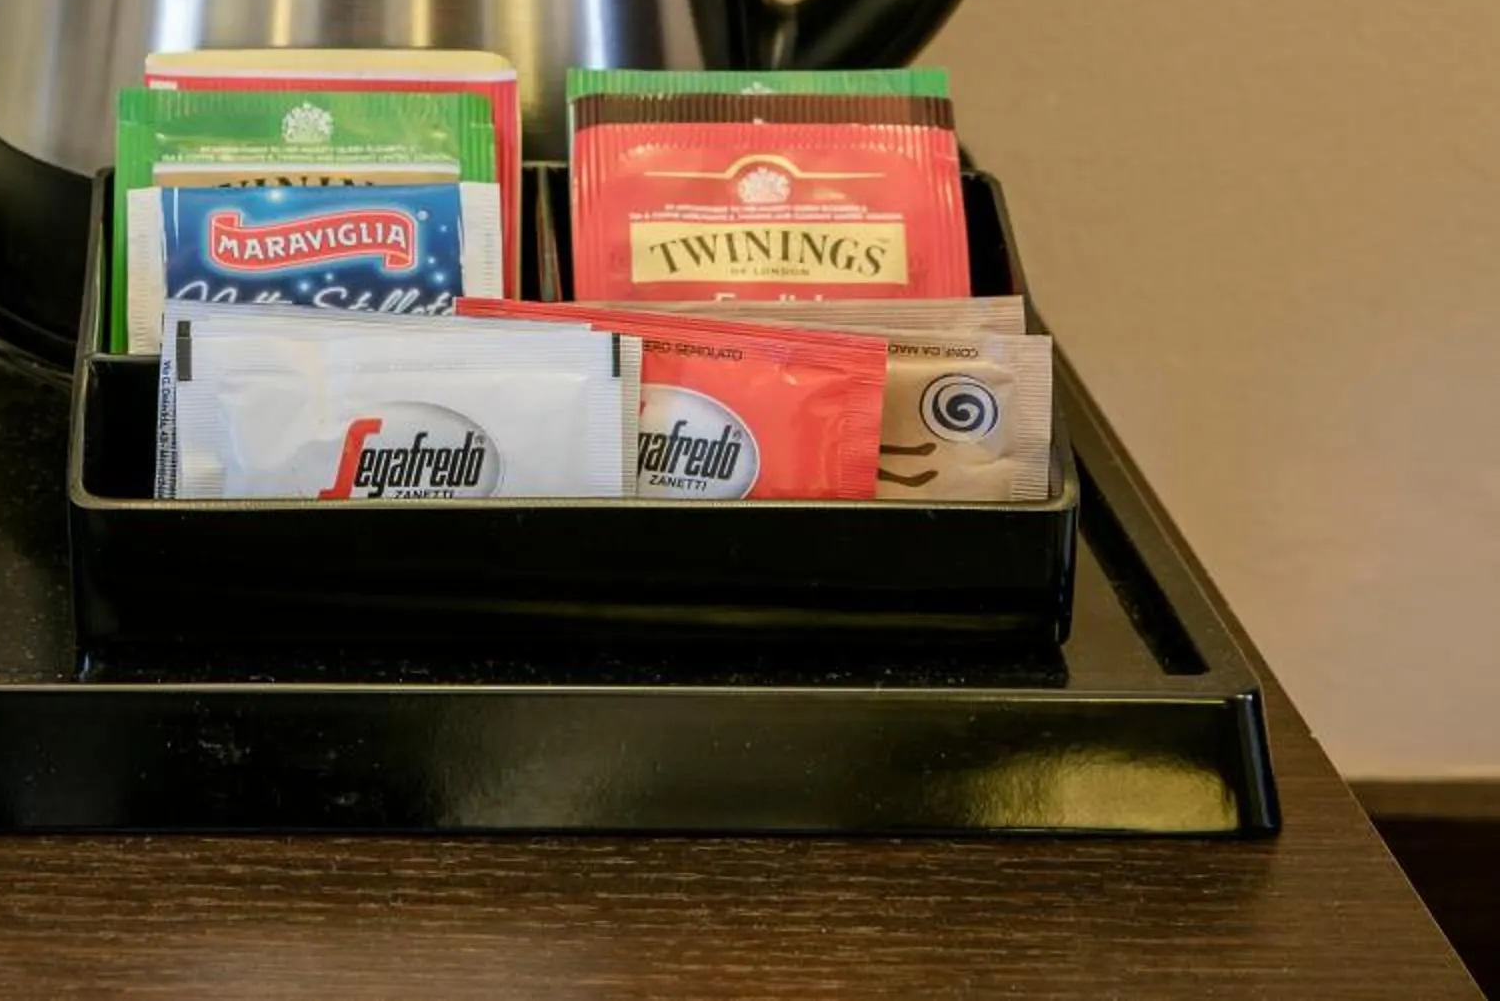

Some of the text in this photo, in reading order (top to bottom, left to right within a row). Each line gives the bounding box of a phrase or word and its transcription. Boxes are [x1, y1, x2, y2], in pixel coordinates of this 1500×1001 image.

[217, 220, 407, 261] MARAVIGLIA
[649, 230, 888, 278] TWININGS
[317, 418, 487, 501] Segafredo
[638, 419, 742, 481] gafredo
[393, 488, 455, 500] ZANETTI
[649, 473, 708, 492] ZANETTI
